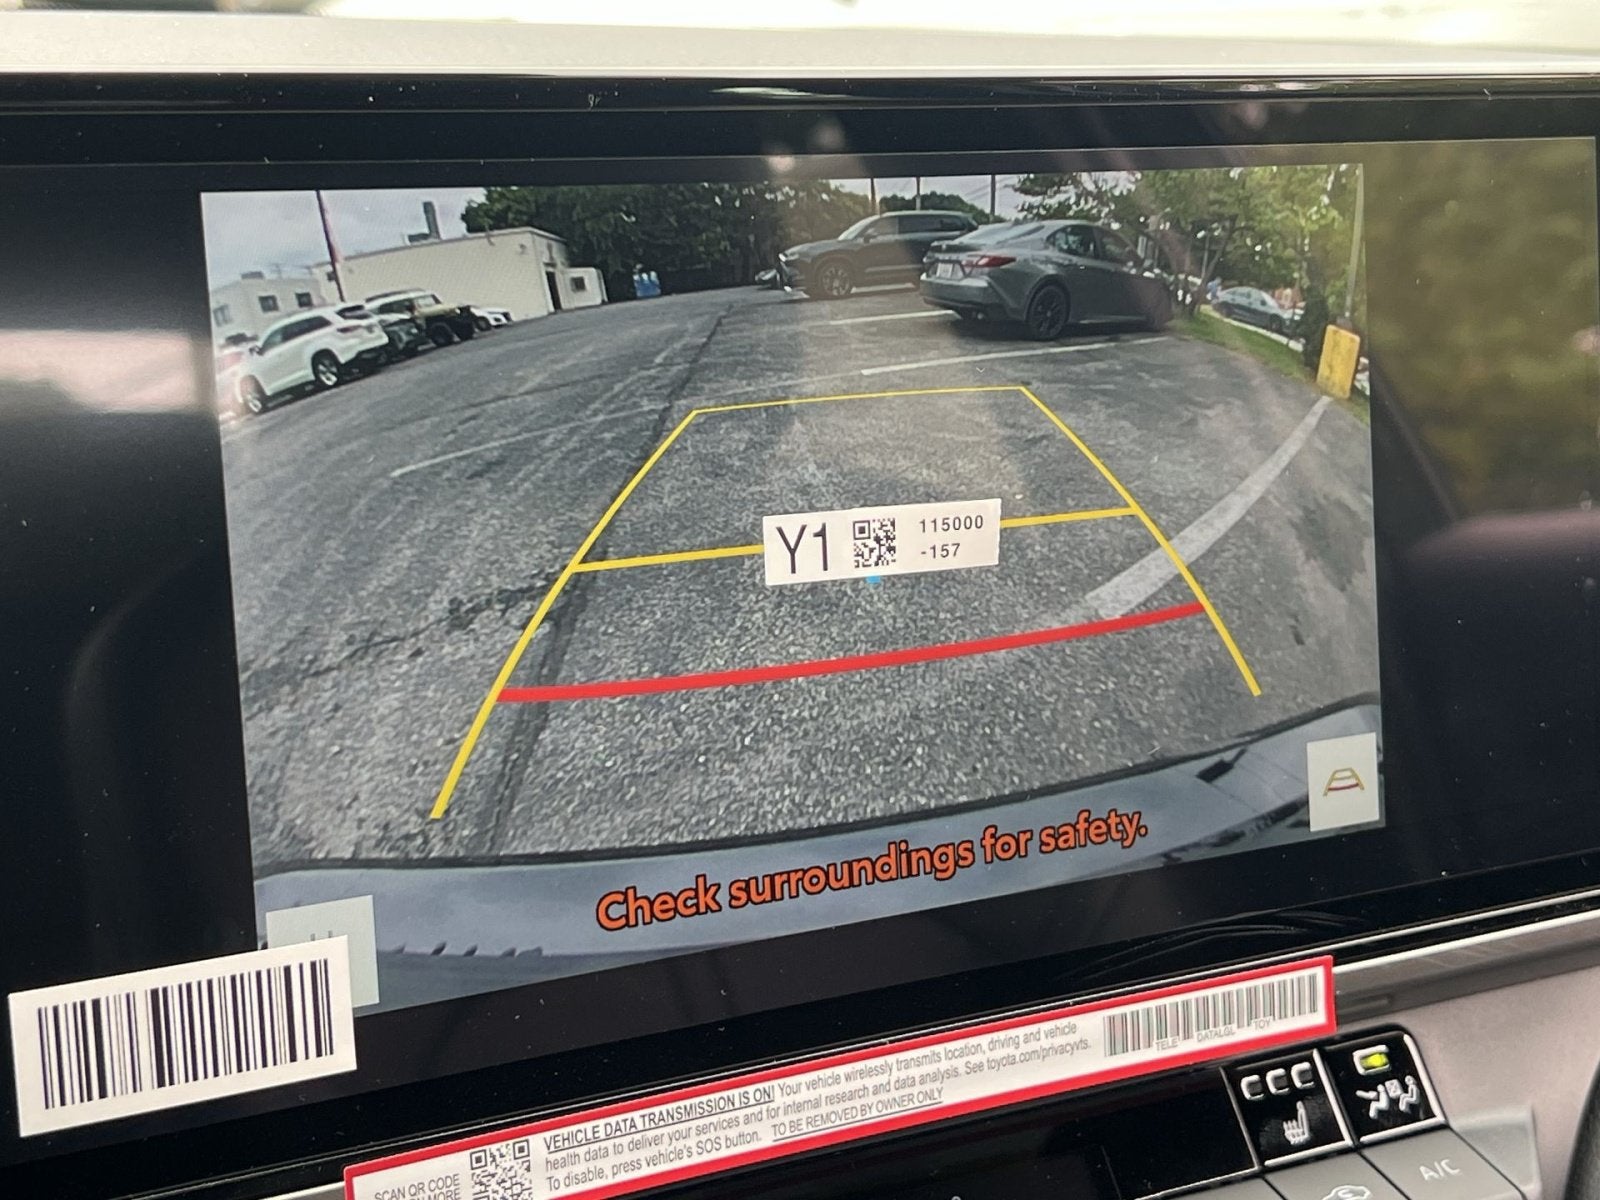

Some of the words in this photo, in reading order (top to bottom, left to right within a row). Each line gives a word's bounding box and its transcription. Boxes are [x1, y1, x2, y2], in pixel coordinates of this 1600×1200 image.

[919, 515, 984, 534] 115000
[776, 522, 829, 574] Y1
[921, 543, 960, 559] -157
[596, 876, 721, 931] Check
[729, 841, 974, 908] surroundings
[980, 825, 1033, 864] for
[1039, 808, 1149, 854] safety.
[1155, 1037, 1178, 1051] TELE
[1253, 1018, 1272, 1031] TOY
[543, 1124, 600, 1151] VEHICLE
[603, 1117, 638, 1137] DATA
[640, 1093, 735, 1128] TRANSMISSION
[738, 1090, 750, 1106] IS
[777, 1080, 802, 1097] Your
[805, 1071, 842, 1091] vehicle
[843, 1059, 894, 1083] wirelessly
[895, 1050, 942, 1072] transmits
[943, 1042, 986, 1062] location,
[987, 1034, 1021, 1052] driving
[1022, 1027, 1041, 1045] and
[1043, 1021, 1078, 1040] vehicle
[545, 1151, 581, 1172] health
[584, 1145, 609, 1163] data
[612, 1141, 625, 1155] to
[627, 1131, 665, 1152] deliver
[667, 1126, 693, 1146] your
[695, 1115, 741, 1138] services
[743, 1109, 764, 1126] and
[766, 1103, 782, 1120] for
[783, 1094, 823, 1117] internal
[824, 1084, 870, 1106] research
[872, 1078, 892, 1096] and
[893, 1072, 917, 1091] data
[918, 1063, 962, 1084] analysis.
[963, 1060, 985, 1076] See
[546, 1175, 561, 1191] To
[563, 1166, 609, 1188] disable,
[611, 1158, 642, 1180] press
[644, 1144, 693, 1168] vehicle's
[696, 1135, 722, 1155] SOS
[724, 1129, 763, 1150] button.
[771, 1122, 787, 1137] TO
[789, 1117, 805, 1134] BE
[806, 1105, 859, 1128] REMOVED
[860, 1101, 875, 1118] BY
[876, 1092, 916, 1113] OWNER
[917, 1086, 944, 1104] ONLY
[428, 1174, 460, 1192] CODE
[1420, 1159, 1461, 1180] A/C
